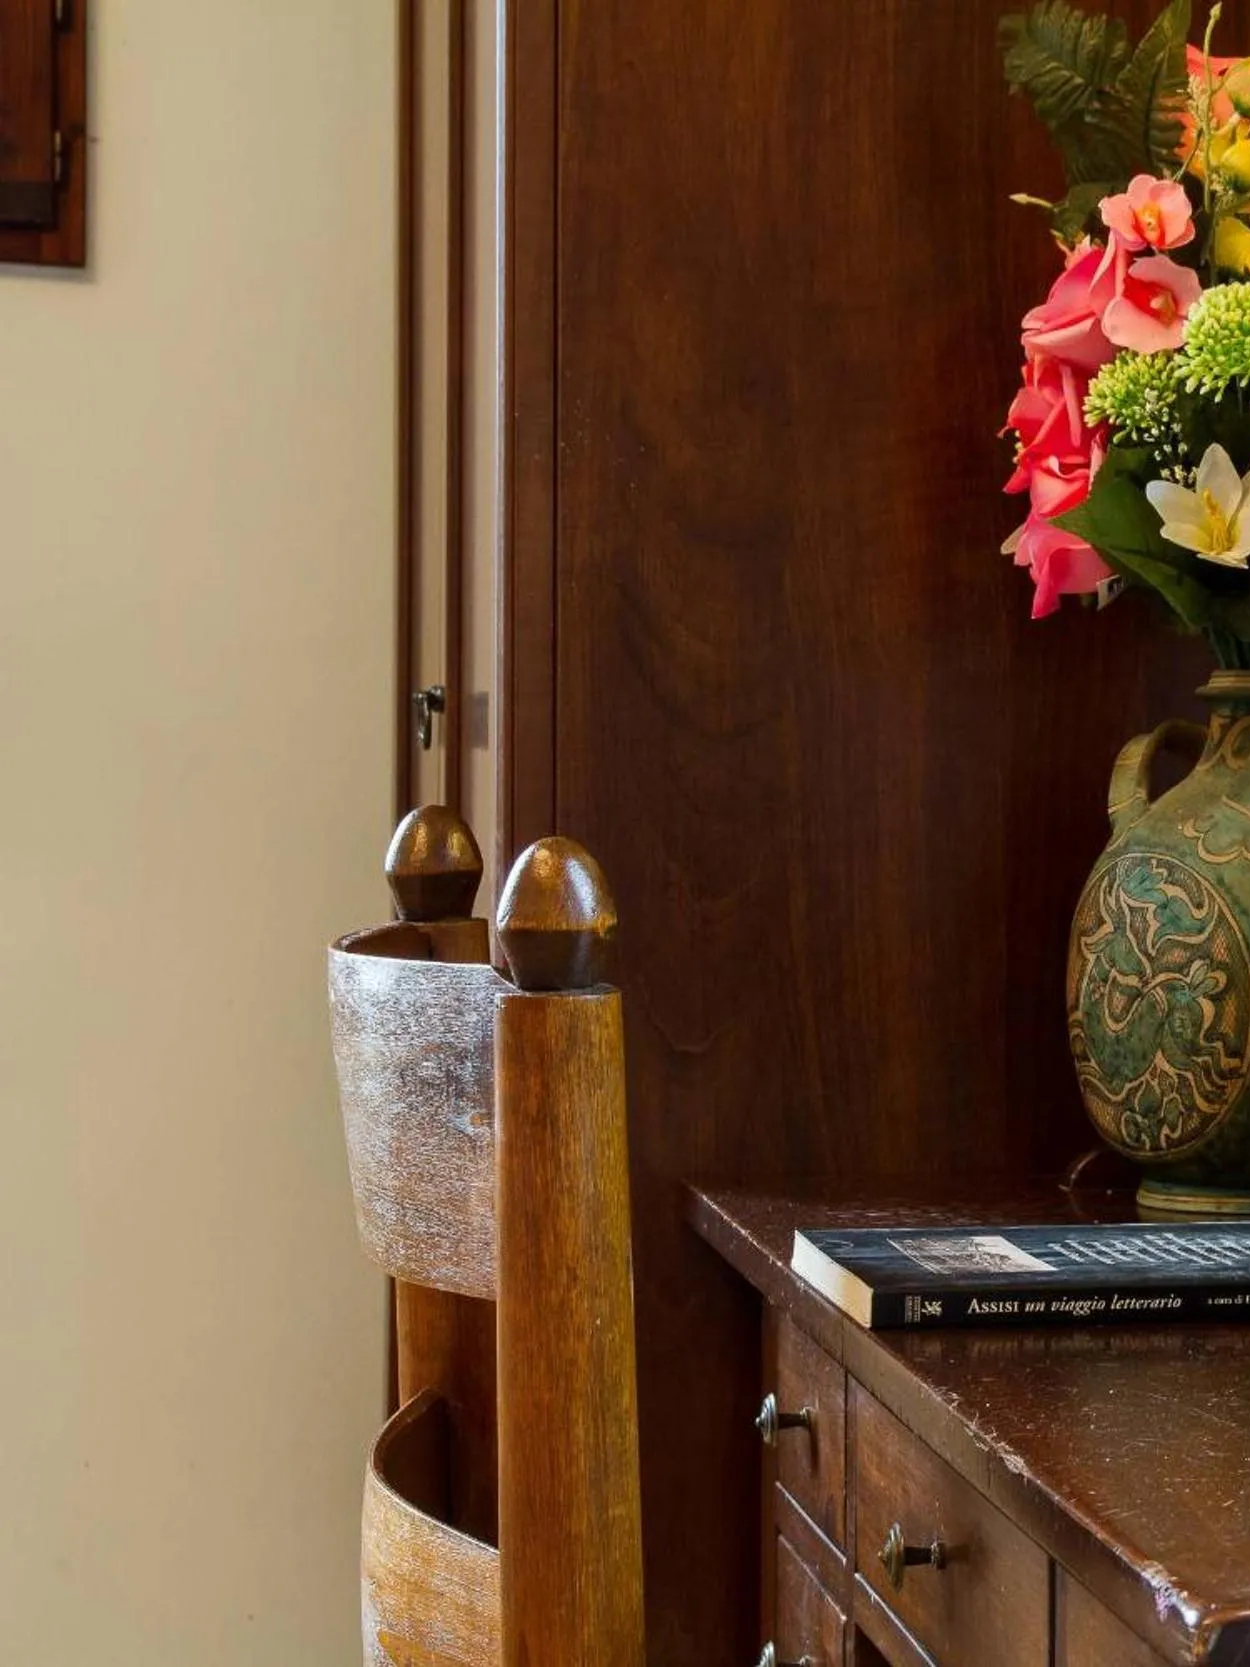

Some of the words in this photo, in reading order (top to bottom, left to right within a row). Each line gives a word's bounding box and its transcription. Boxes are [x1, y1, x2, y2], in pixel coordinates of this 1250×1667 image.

[967, 1298, 1019, 1315] ASSISI
[1024, 1300, 1045, 1312] un
[1050, 1296, 1106, 1316] viaggio
[1110, 1293, 1182, 1310] letterario
